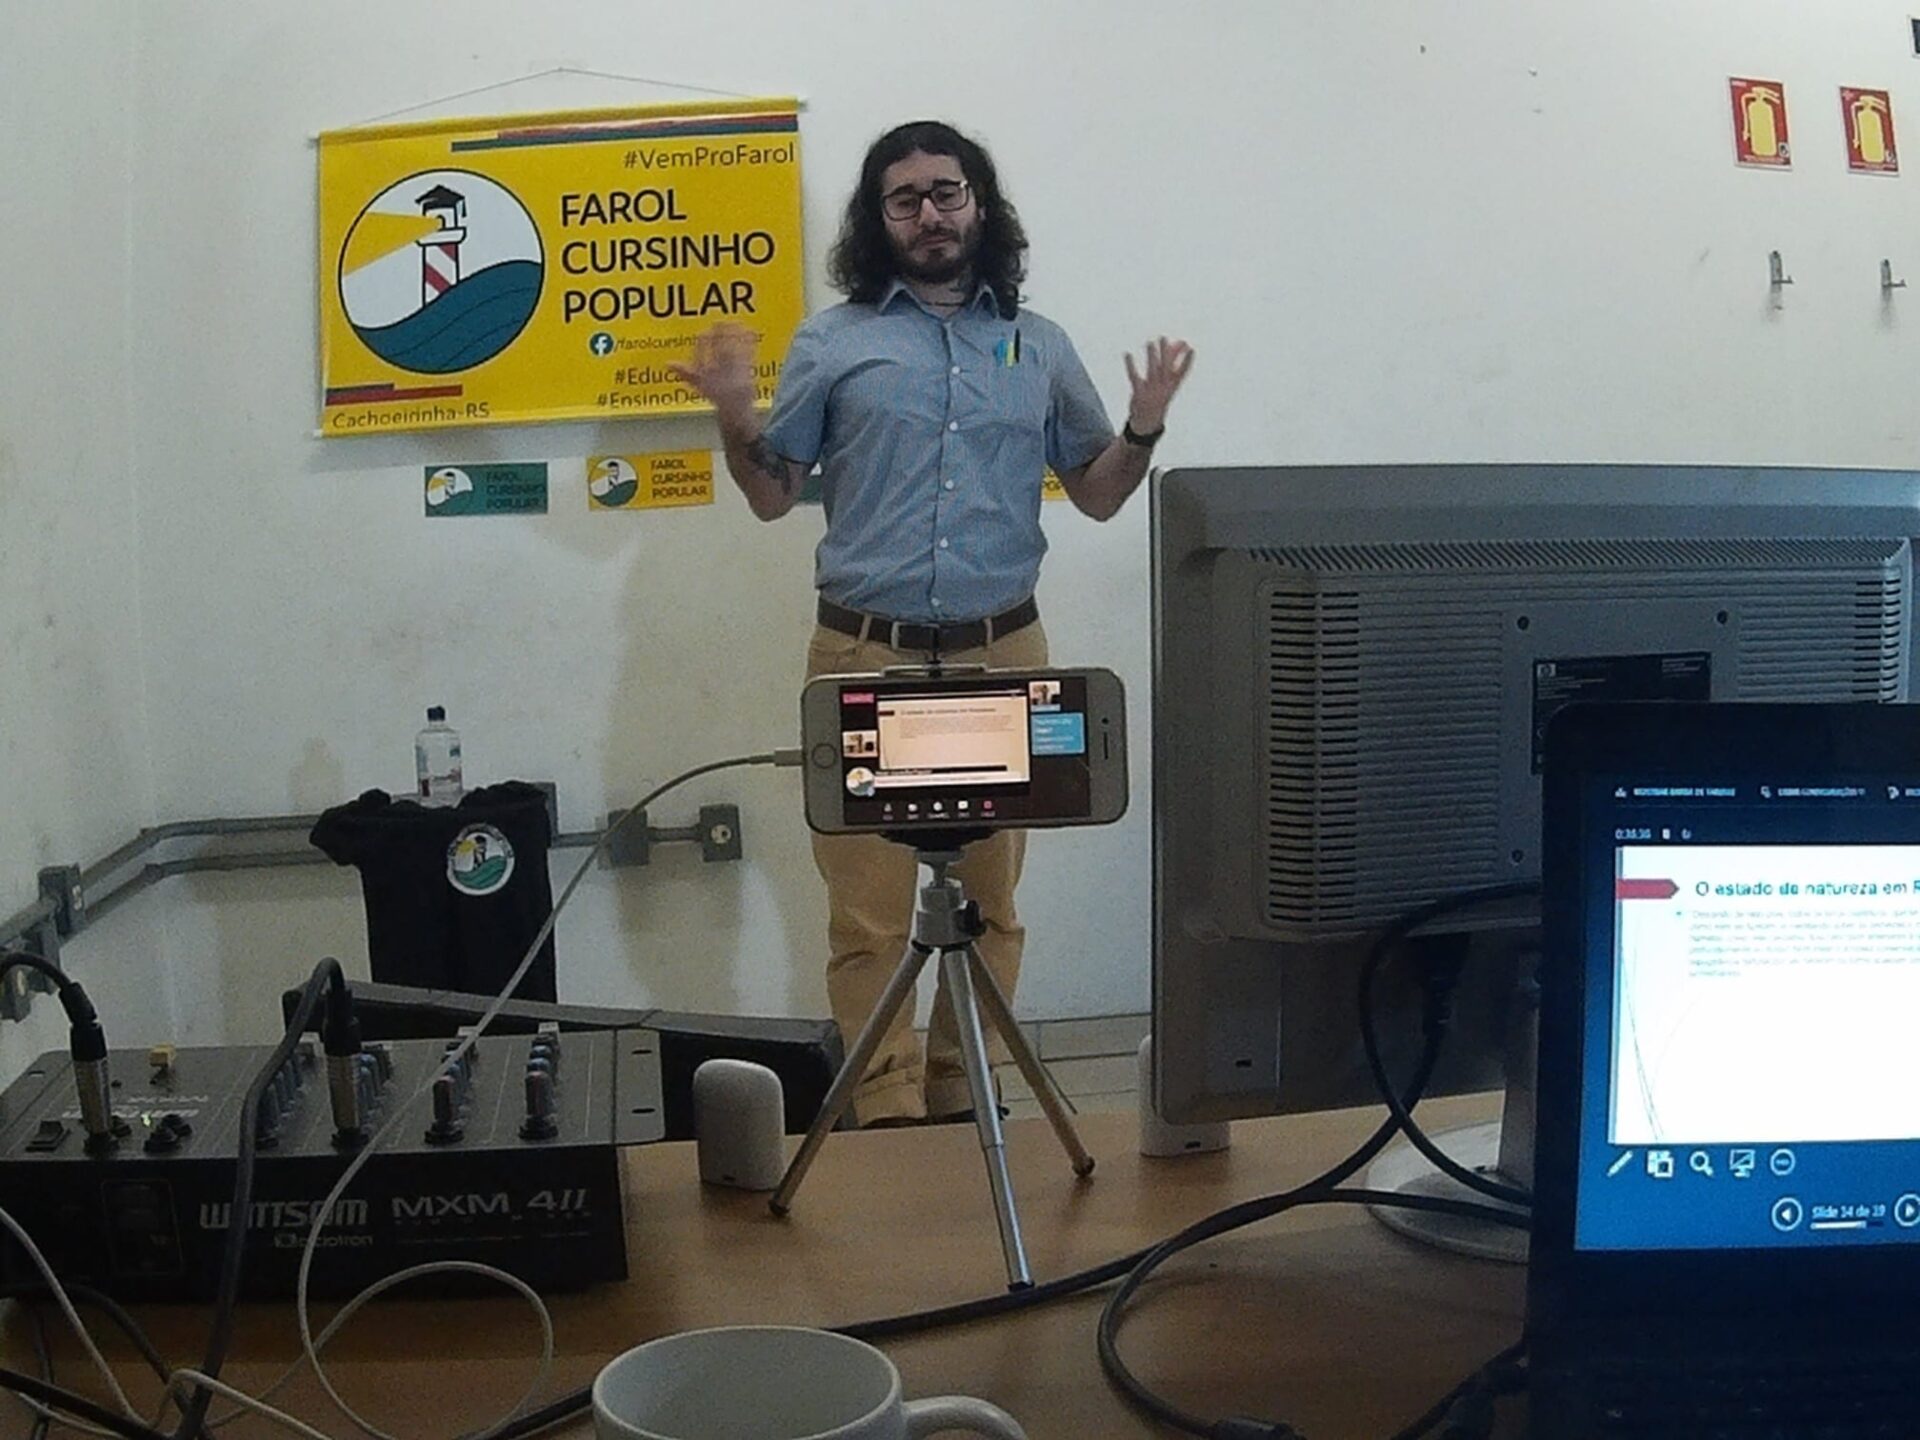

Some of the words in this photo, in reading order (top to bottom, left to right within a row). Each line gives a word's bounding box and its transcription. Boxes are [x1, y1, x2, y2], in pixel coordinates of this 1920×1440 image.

[624, 141, 795, 170] #VemProFarol
[560, 188, 687, 227] FAROL
[561, 231, 776, 276] CURSINHO
[563, 281, 755, 323] POPULAR
[332, 402, 490, 429] Cachoeirinha-RS
[652, 485, 708, 499] POPULAR
[1695, 881, 1710, 896] O
[1715, 881, 1774, 896] estado
[1779, 881, 1799, 896] de
[1805, 881, 1877, 896] natureza
[1882, 882, 1908, 895] em
[391, 1192, 511, 1218] MXM
[1841, 1205, 1854, 1218] 14
